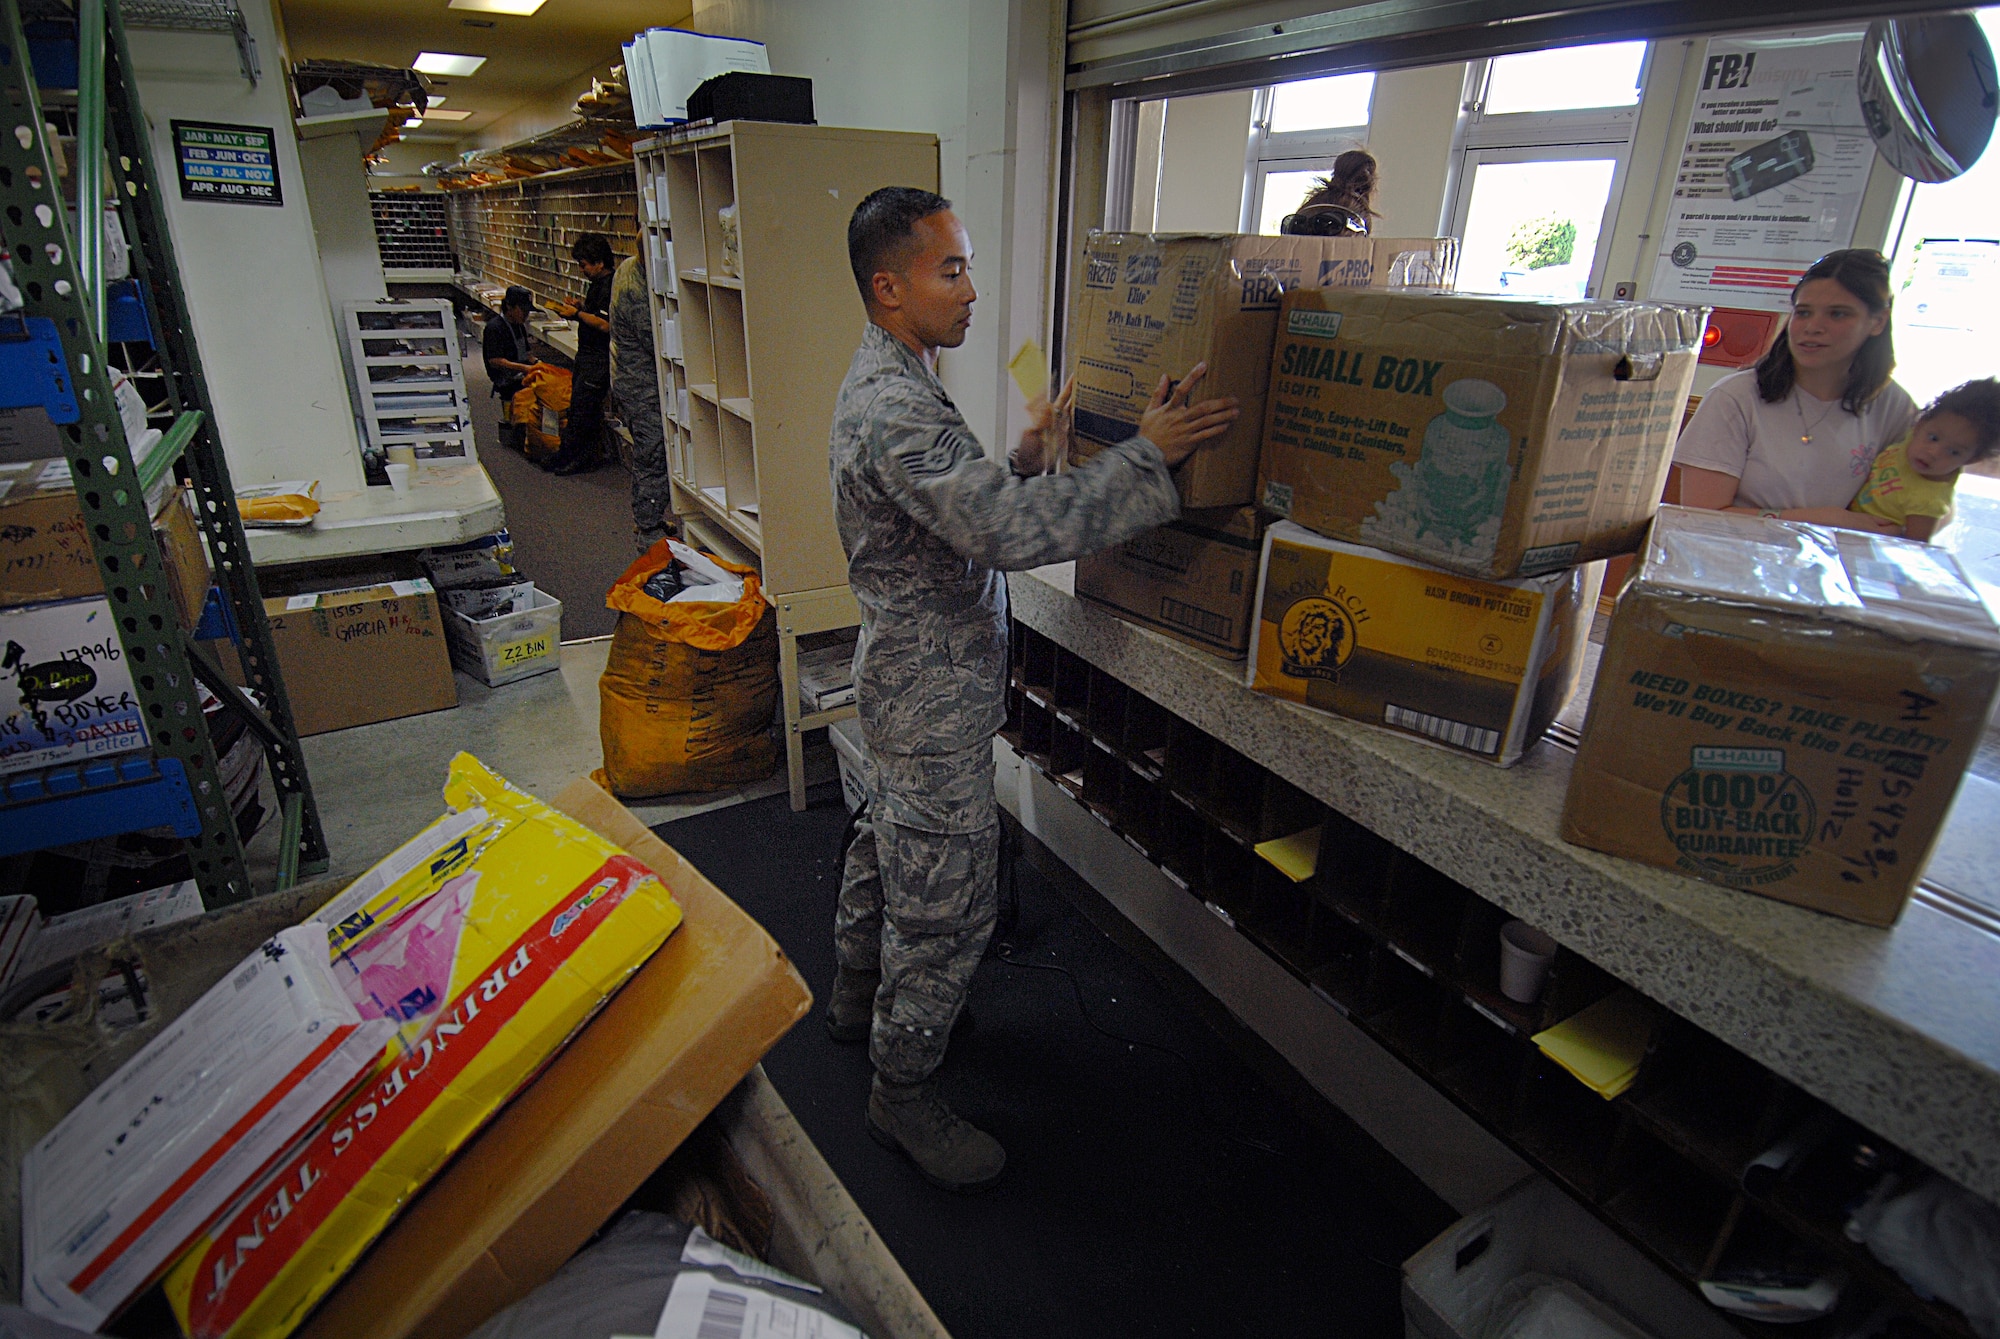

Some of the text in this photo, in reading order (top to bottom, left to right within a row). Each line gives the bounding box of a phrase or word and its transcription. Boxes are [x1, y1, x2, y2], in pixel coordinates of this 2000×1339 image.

[1703, 52, 1756, 90] FBI
[1693, 118, 1778, 134] What should you do?
[185, 131, 264, 146] JAN MAY SEP
[188, 149, 266, 163] FEB JUN OCT
[189, 165, 270, 180] MAR JUL NOV
[192, 182, 273, 197] APR AUG DEC
[1685, 213, 1704, 221] parcel
[1246, 259, 1286, 268] REORDER
[1281, 343, 1445, 397] SMALL BOX
[1301, 406, 1325, 423] Duty,
[1328, 411, 1388, 433] Easy-to-Lift
[1391, 422, 1411, 439] Box
[1558, 427, 1597, 441] Packing
[1303, 437, 1345, 458] Clothing,
[1347, 447, 1367, 462] Etc.
[1314, 425, 1337, 439] such
[1339, 430, 1351, 441] as
[1353, 432, 1407, 457] Canisters,
[332, 599, 400, 619] 15155 8/8
[1425, 585, 1532, 618] HASH BROWN POTATOES
[335, 619, 388, 643] GARCIA
[60, 637, 120, 662] 17996
[526, 640, 546, 655] BIN
[54, 690, 140, 728] BOYER
[1629, 669, 1951, 756] NEED BOXES? TAKE PLENTY!
[1632, 691, 1688, 717] We'll
[1688, 703, 1734, 731] Buy
[1736, 716, 1798, 744] Back
[1800, 730, 1842, 753] the
[84, 734, 138, 755] Letter
[1679, 772, 1798, 813] 100%
[1675, 807, 1802, 835] BUY-BACK
[1676, 834, 1801, 858] GUARANTEE
[206, 943, 533, 1302] PRINCESS TENT
